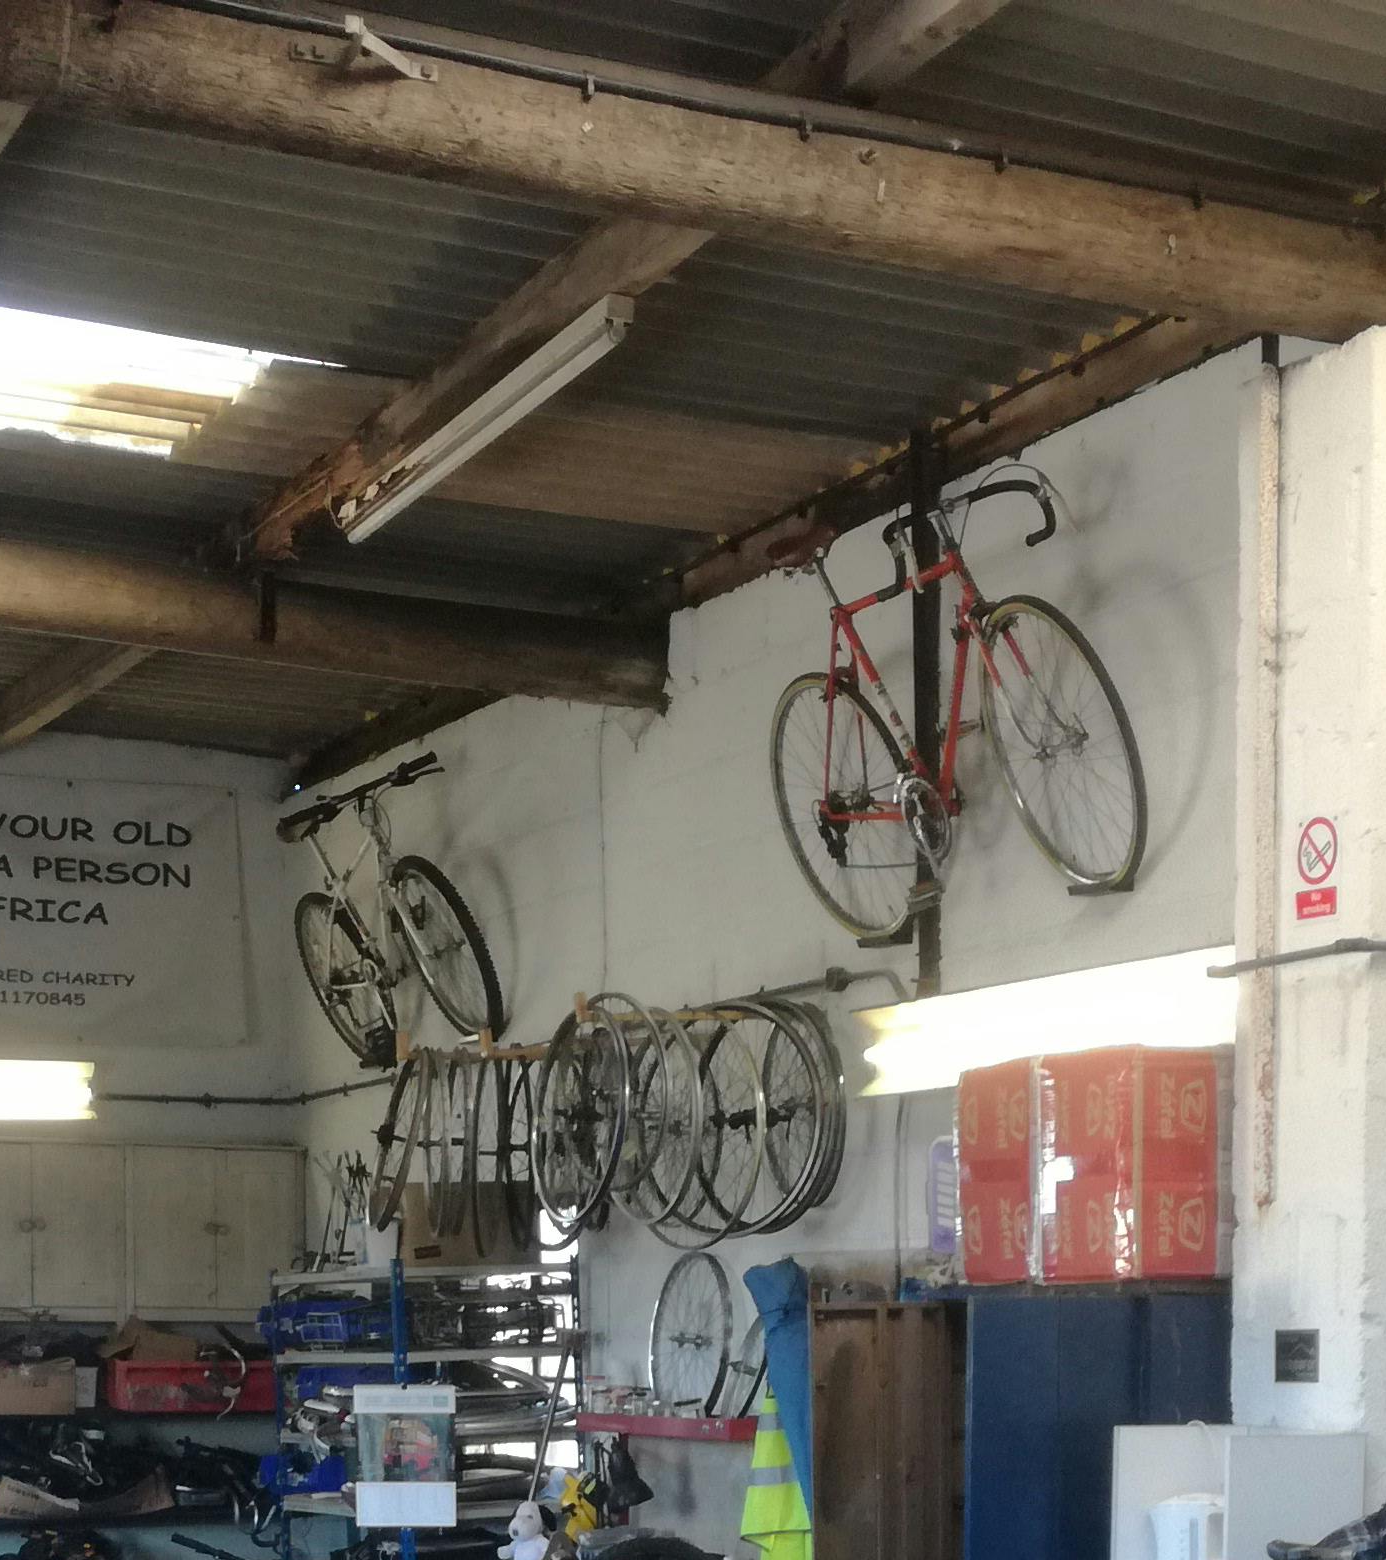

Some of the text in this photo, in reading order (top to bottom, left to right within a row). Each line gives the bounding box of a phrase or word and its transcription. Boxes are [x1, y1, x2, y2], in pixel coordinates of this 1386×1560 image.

[113, 818, 193, 849] OLD
[33, 855, 192, 889] PERSON
[1302, 903, 1331, 915] smoking
[41, 968, 137, 989] CHARITY
[0, 988, 87, 1008] 1170845
